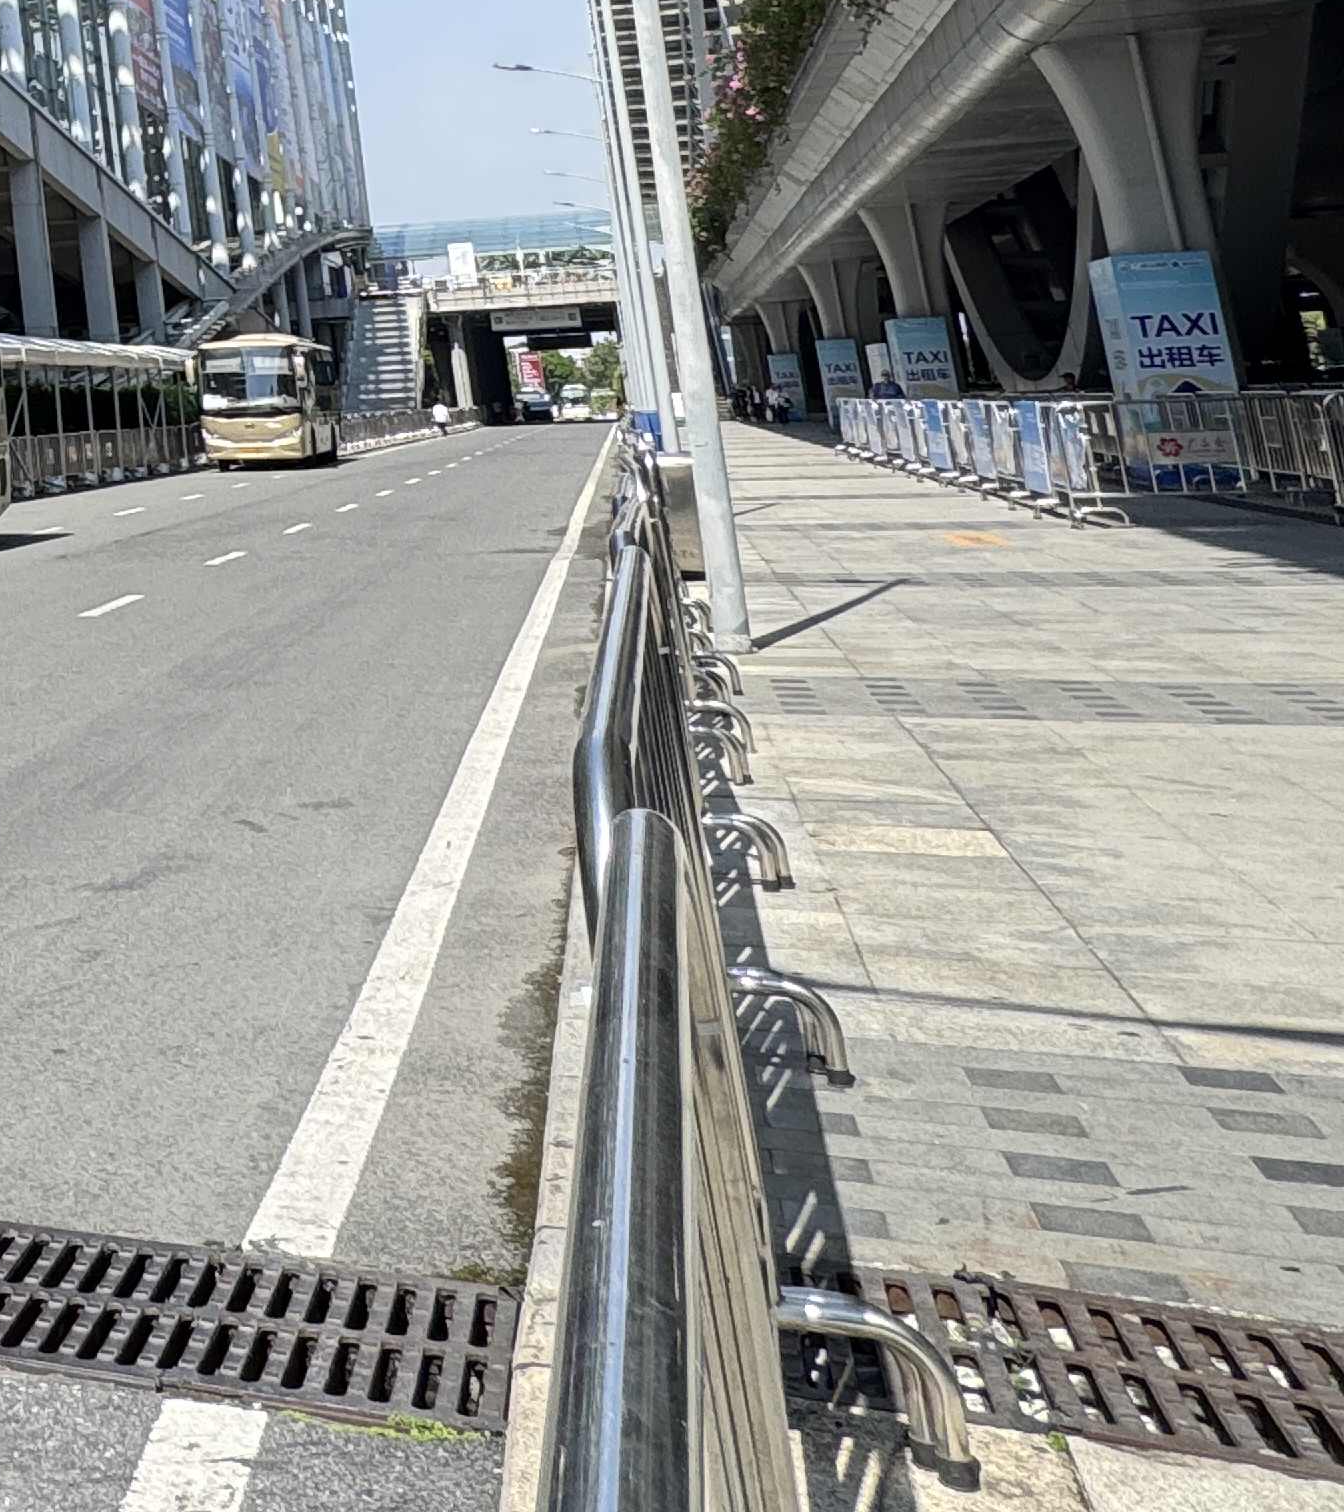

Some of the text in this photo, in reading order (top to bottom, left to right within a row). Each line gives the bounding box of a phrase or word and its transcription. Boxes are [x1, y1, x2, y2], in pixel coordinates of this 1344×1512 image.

[1129, 312, 1219, 338] TAXI
[902, 350, 949, 365] TAXI
[1138, 344, 1226, 369] 出租车
[825, 362, 857, 374] TAXI
[907, 368, 951, 381] 出租车
